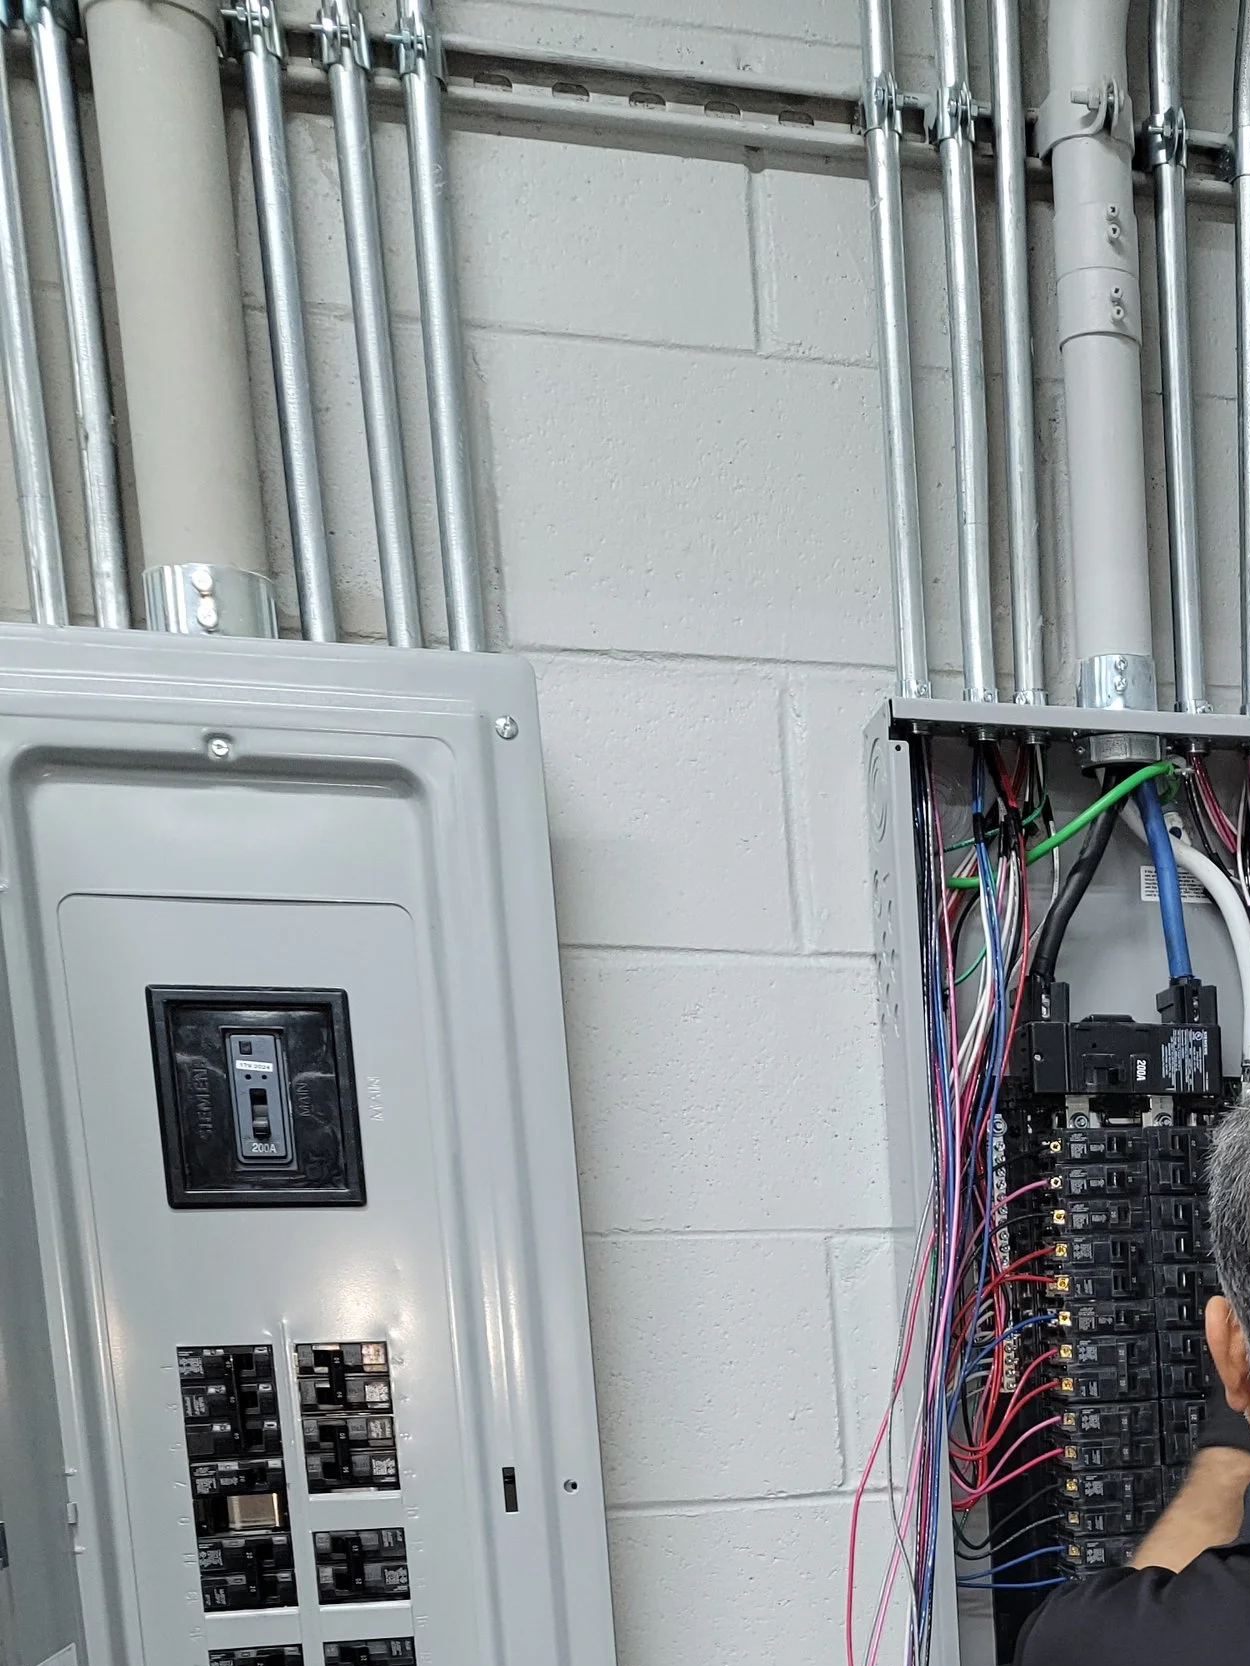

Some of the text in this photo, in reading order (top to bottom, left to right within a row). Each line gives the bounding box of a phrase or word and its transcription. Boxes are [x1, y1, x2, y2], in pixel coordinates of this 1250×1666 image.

[1136, 1059, 1147, 1082] 200A
[296, 1081, 312, 1117] MAIN
[366, 1075, 385, 1122] MAIN
[251, 1142, 277, 1154] 200A
